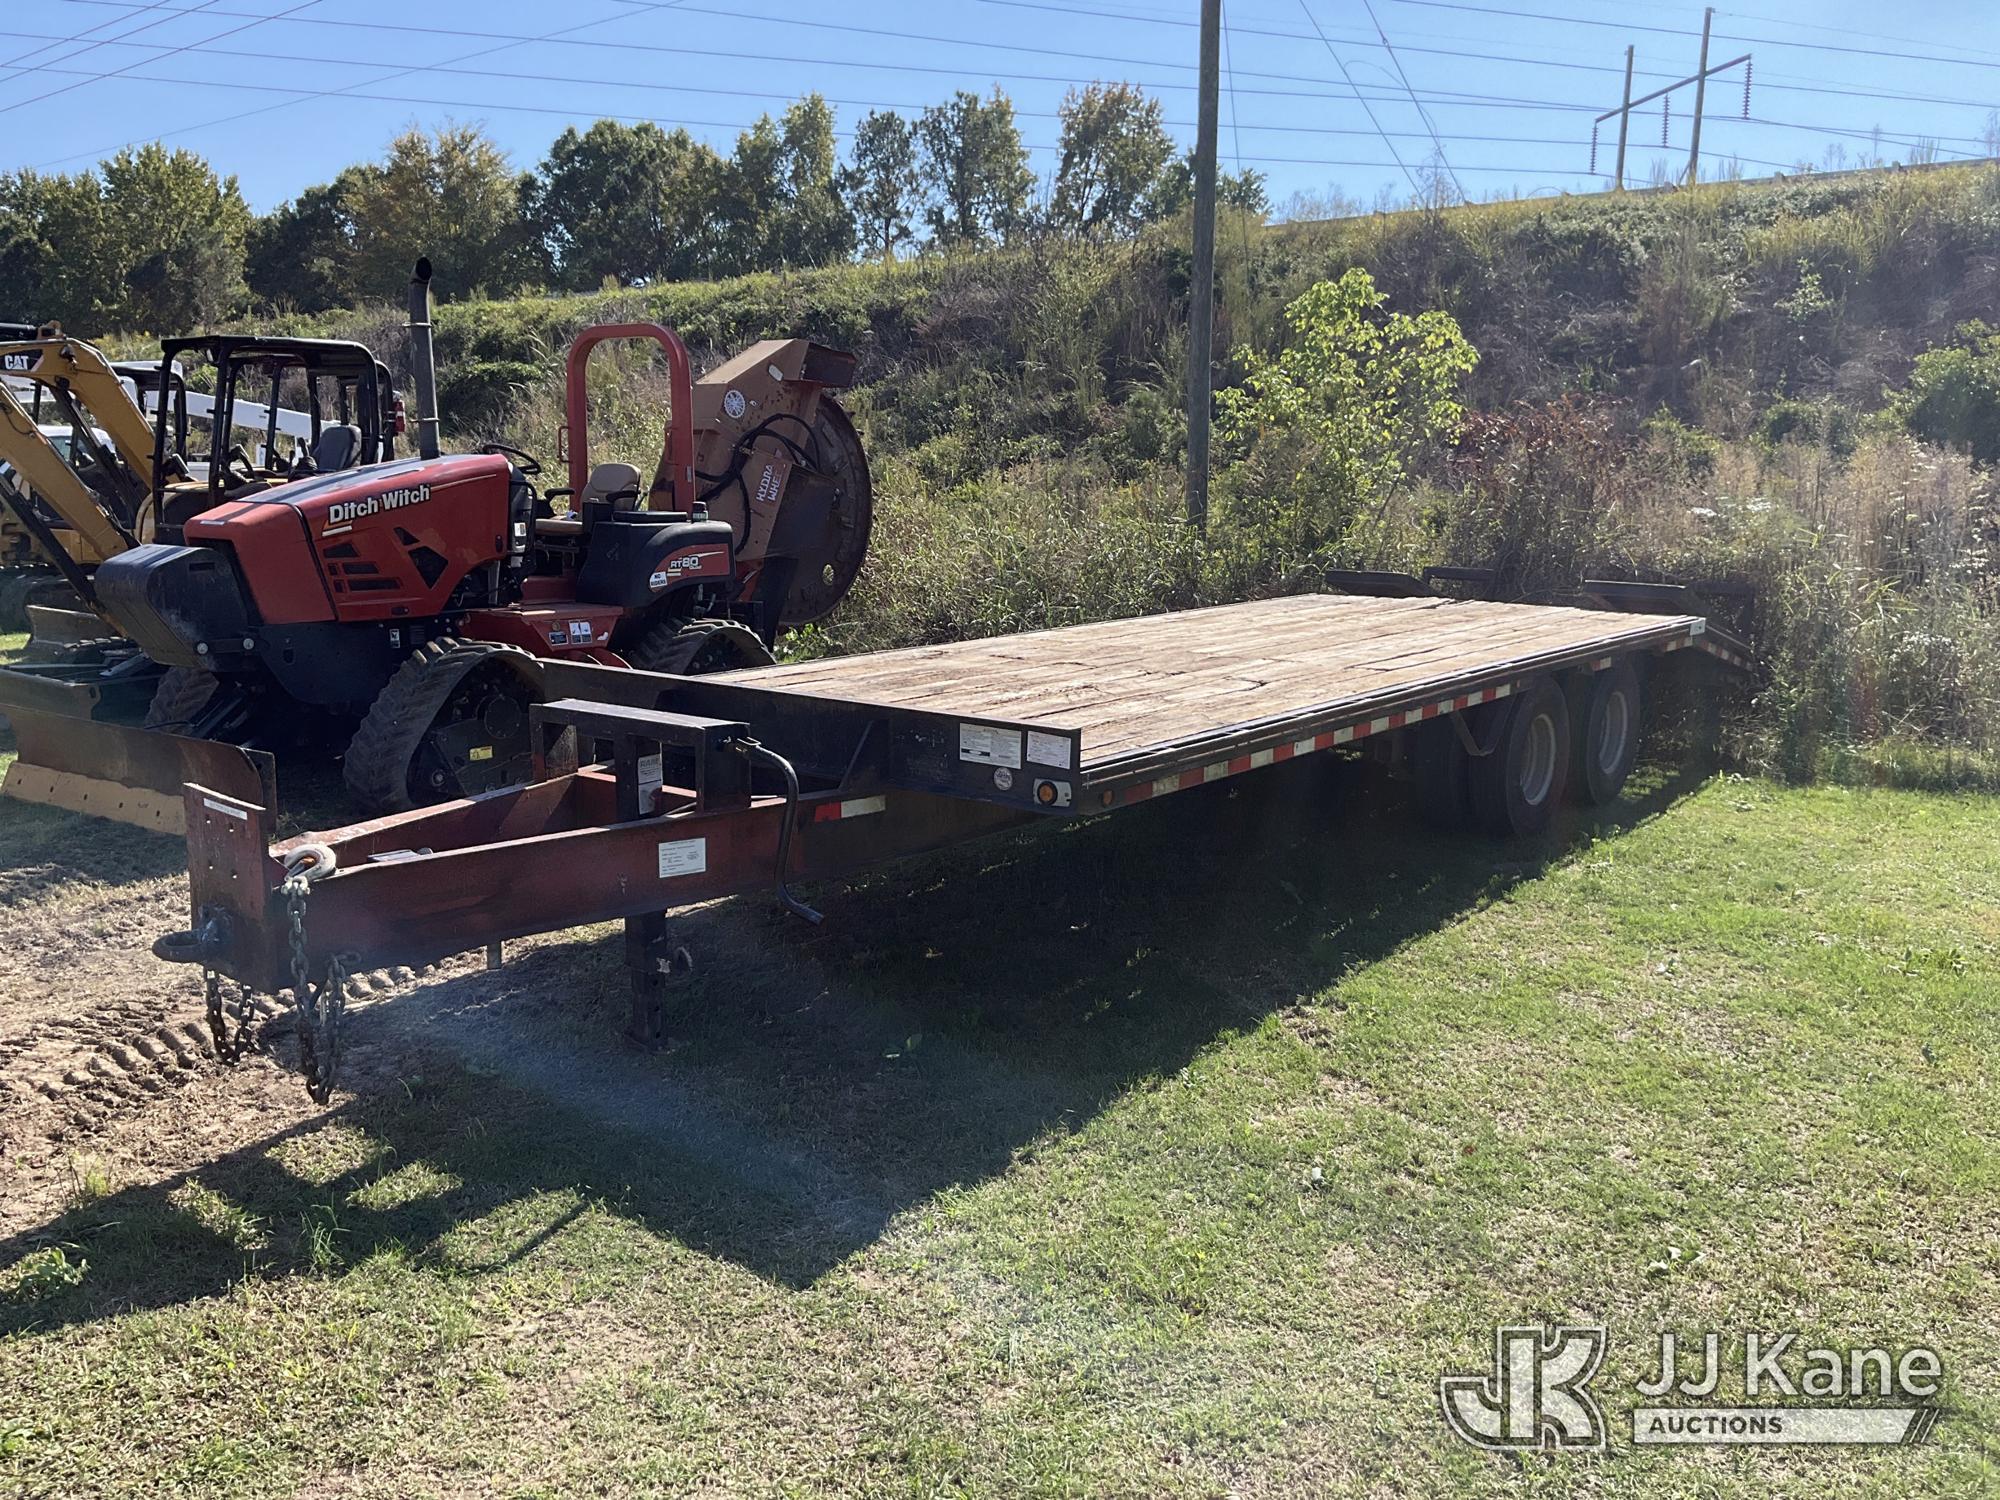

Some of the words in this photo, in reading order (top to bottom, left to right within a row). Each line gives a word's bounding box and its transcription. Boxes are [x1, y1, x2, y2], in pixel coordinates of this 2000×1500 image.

[4, 355, 29, 370] CAT
[756, 464, 774, 501] HYDRA
[329, 497, 378, 523] Ditch
[382, 485, 430, 510] Witch
[670, 556, 699, 569] RT80
